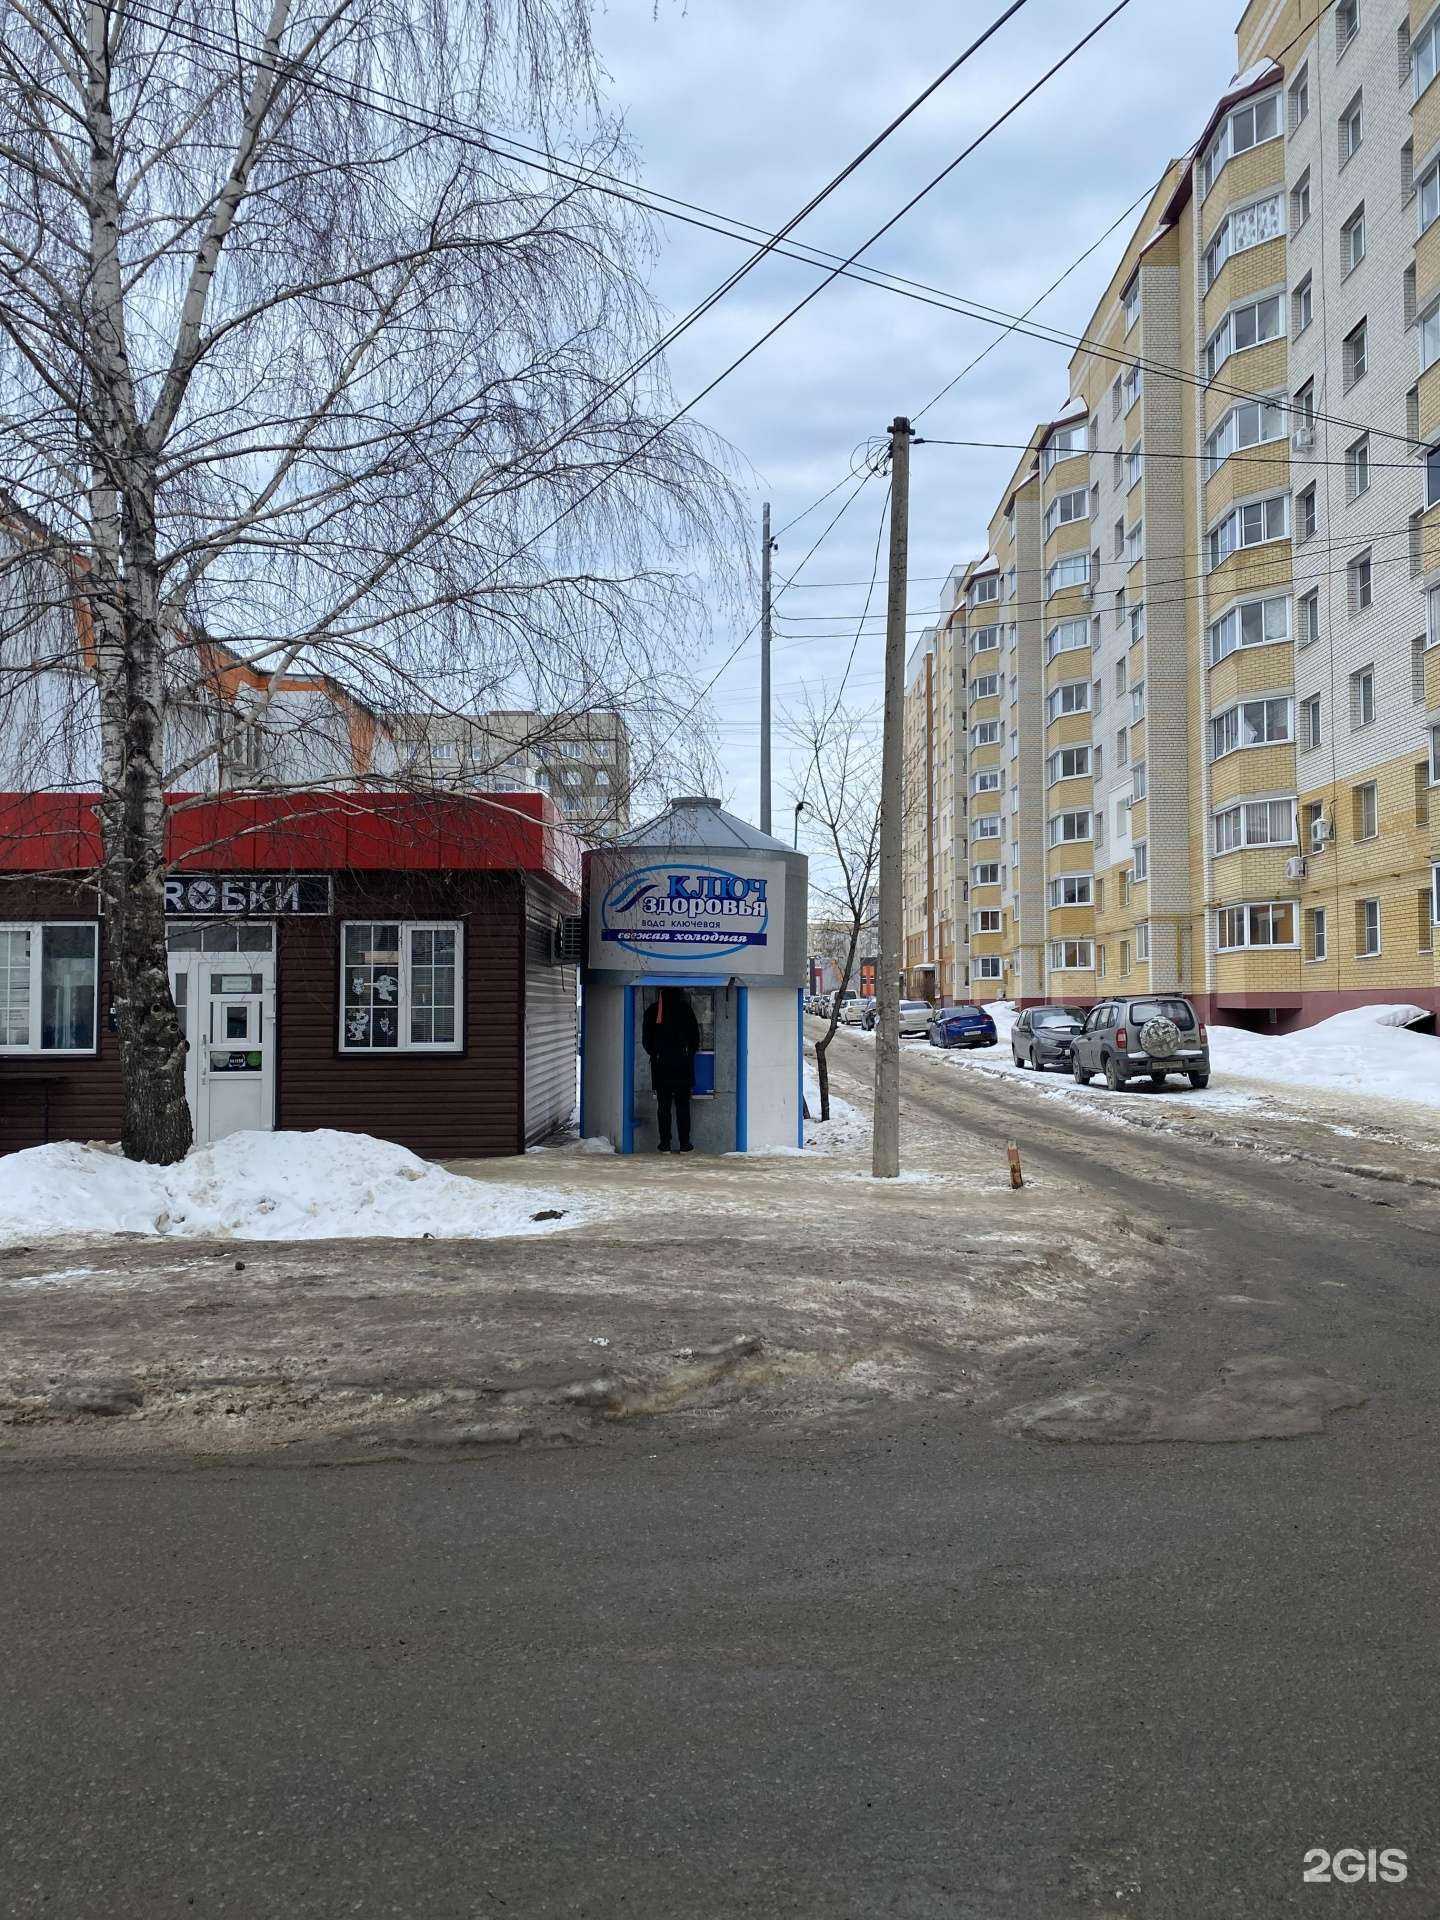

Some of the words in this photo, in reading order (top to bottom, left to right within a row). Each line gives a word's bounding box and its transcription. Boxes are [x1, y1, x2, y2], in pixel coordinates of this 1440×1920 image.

[643, 897, 766, 918] здоровья
[641, 919, 665, 928] вода
[671, 920, 721, 929] ключевая
[674, 932, 748, 943] холодная
